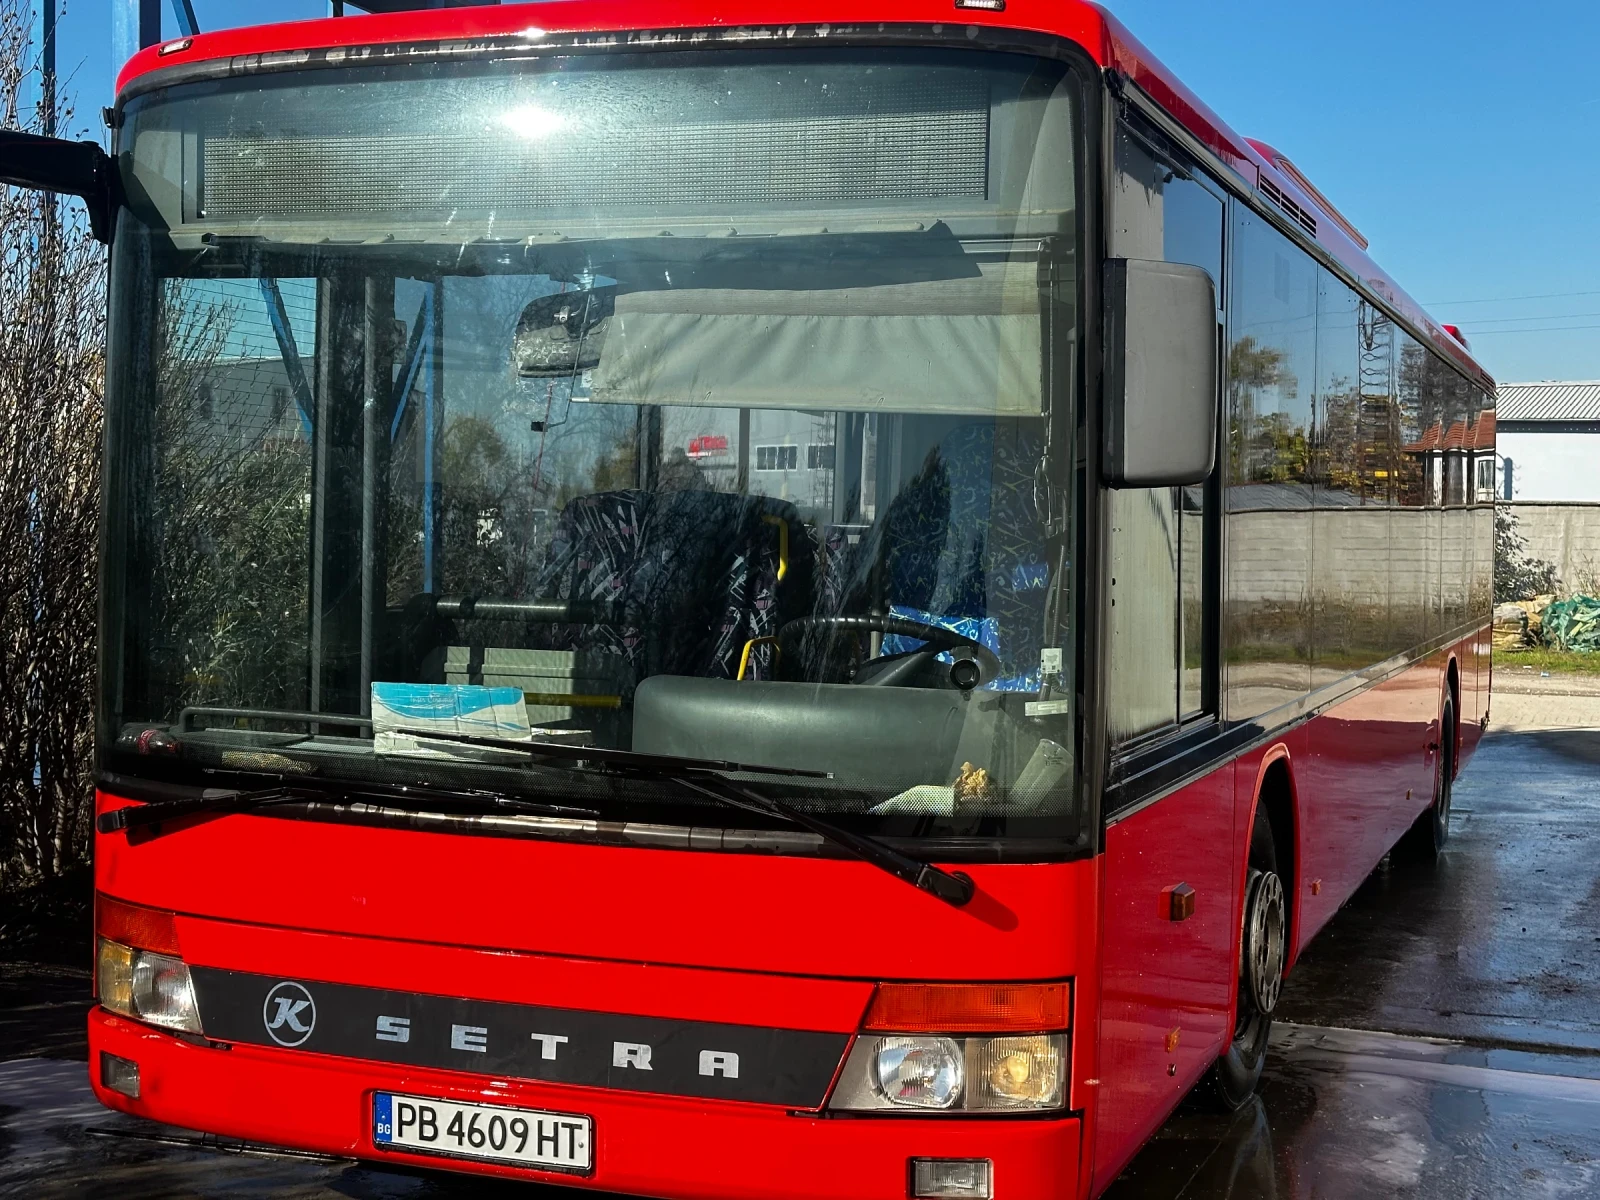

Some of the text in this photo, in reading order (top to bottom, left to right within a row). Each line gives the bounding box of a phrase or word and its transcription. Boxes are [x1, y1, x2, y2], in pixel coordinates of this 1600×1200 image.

[268, 996, 310, 1033] K
[375, 1015, 740, 1079] SETRA
[377, 1122, 391, 1135] BG
[446, 1110, 529, 1154] 4609
